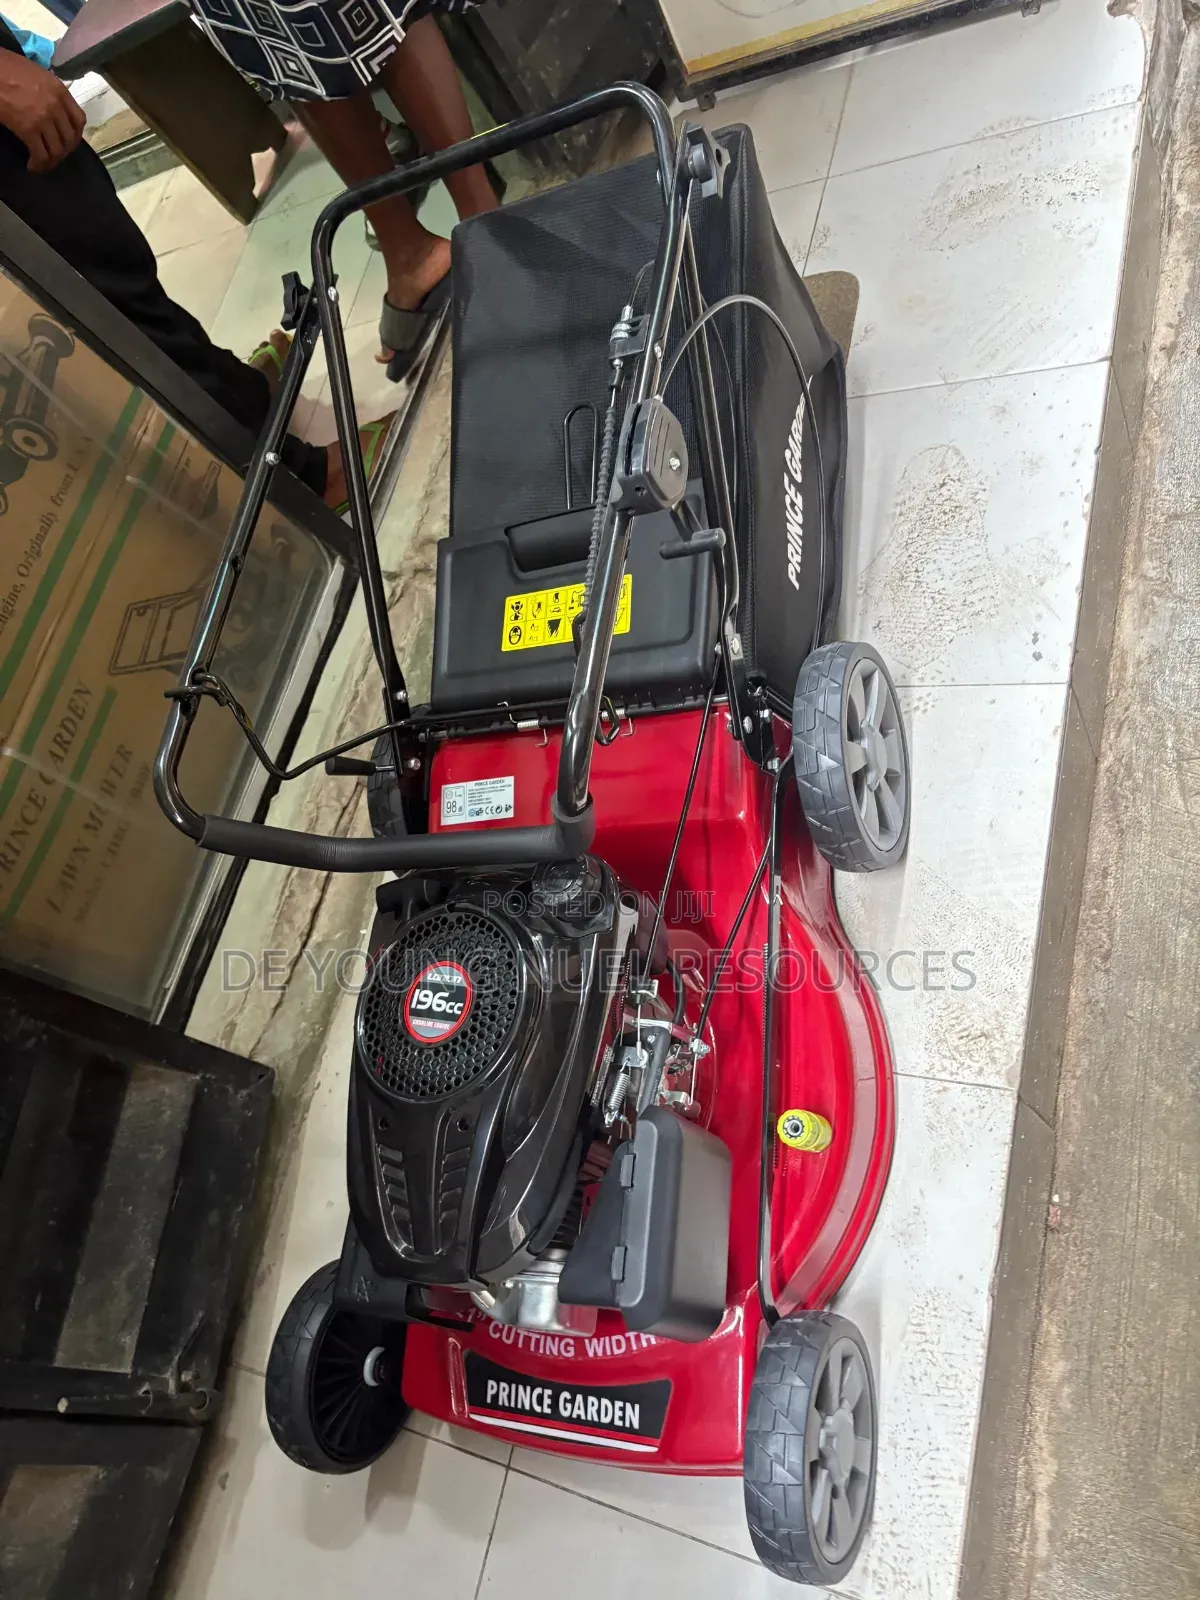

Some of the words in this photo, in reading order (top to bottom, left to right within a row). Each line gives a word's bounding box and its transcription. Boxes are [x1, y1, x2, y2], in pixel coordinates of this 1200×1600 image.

[0, 580, 27, 632] ngine,
[16, 511, 60, 578] Originally
[50, 471, 74, 508] from
[783, 472, 803, 591] PRINCE
[0, 787, 49, 888] RINCE
[446, 800, 457, 813] 98
[46, 837, 91, 914] LAWN
[410, 989, 464, 1014] 196cc
[488, 1320, 575, 1357] CUTTING
[584, 1331, 657, 1357] WIDTH
[486, 1379, 552, 1414] PRINCE
[558, 1391, 640, 1430] GARDEN
